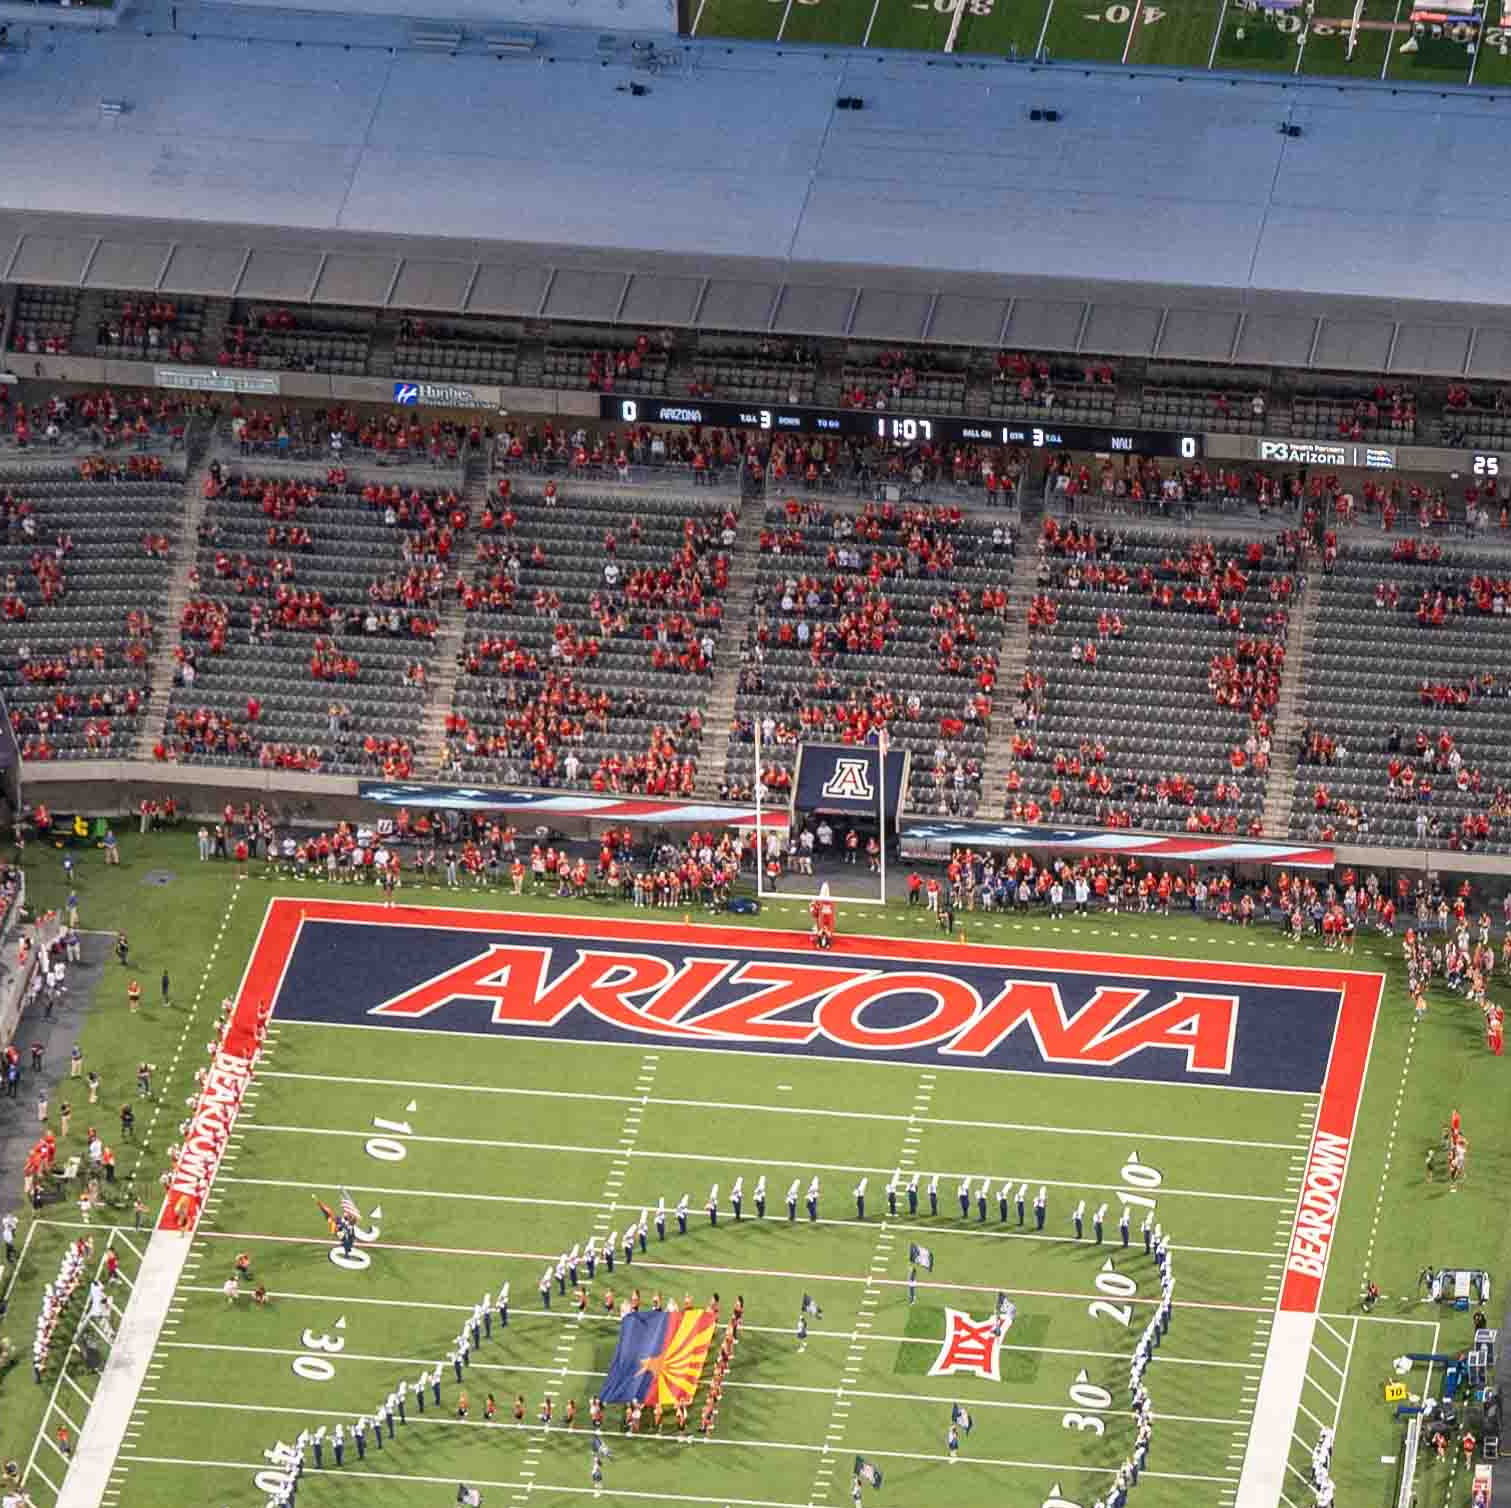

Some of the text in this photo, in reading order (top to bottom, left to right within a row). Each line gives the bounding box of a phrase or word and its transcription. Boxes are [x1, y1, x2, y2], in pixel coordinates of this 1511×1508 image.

[622, 400, 637, 422] 0
[659, 407, 702, 423] ARIZONA
[760, 410, 771, 429] 3
[878, 418, 931, 440] 11:07
[1032, 428, 1044, 448] 3
[1111, 437, 1133, 450] NAU
[1180, 437, 1196, 458] 0
[1260, 441, 1287, 461] P3
[1289, 450, 1345, 465] Arizona
[1472, 456, 1499, 475] 25
[822, 758, 874, 800] A
[365, 942, 1241, 1076] ARIZONA
[365, 1116, 413, 1162] 10
[1116, 1164, 1163, 1209] 10
[1089, 1271, 1138, 1327] 20
[292, 1327, 345, 1381] 30
[1062, 1383, 1112, 1437] 30
